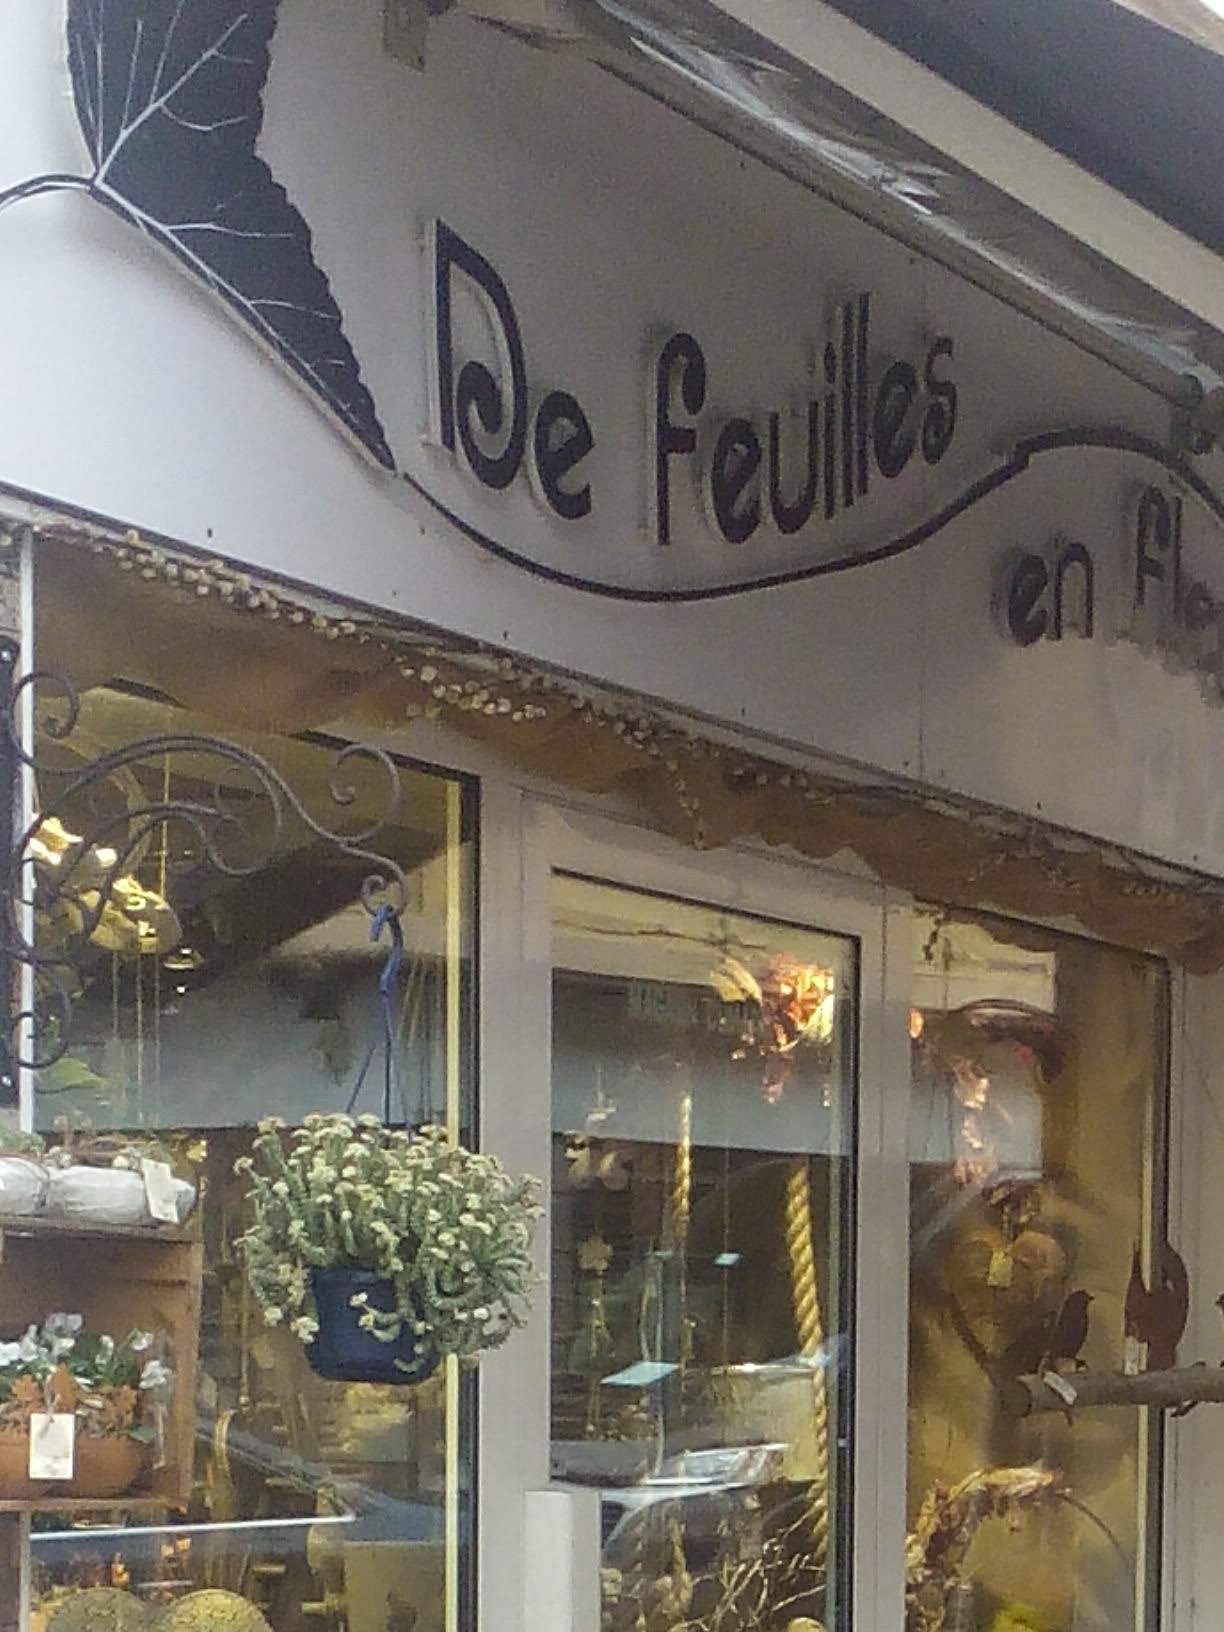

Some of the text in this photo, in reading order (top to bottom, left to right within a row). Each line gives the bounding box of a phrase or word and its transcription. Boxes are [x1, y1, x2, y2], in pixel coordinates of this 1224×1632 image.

[434, 217, 595, 521] De
[656, 290, 957, 546] feuilles
[1008, 541, 1094, 648] en
